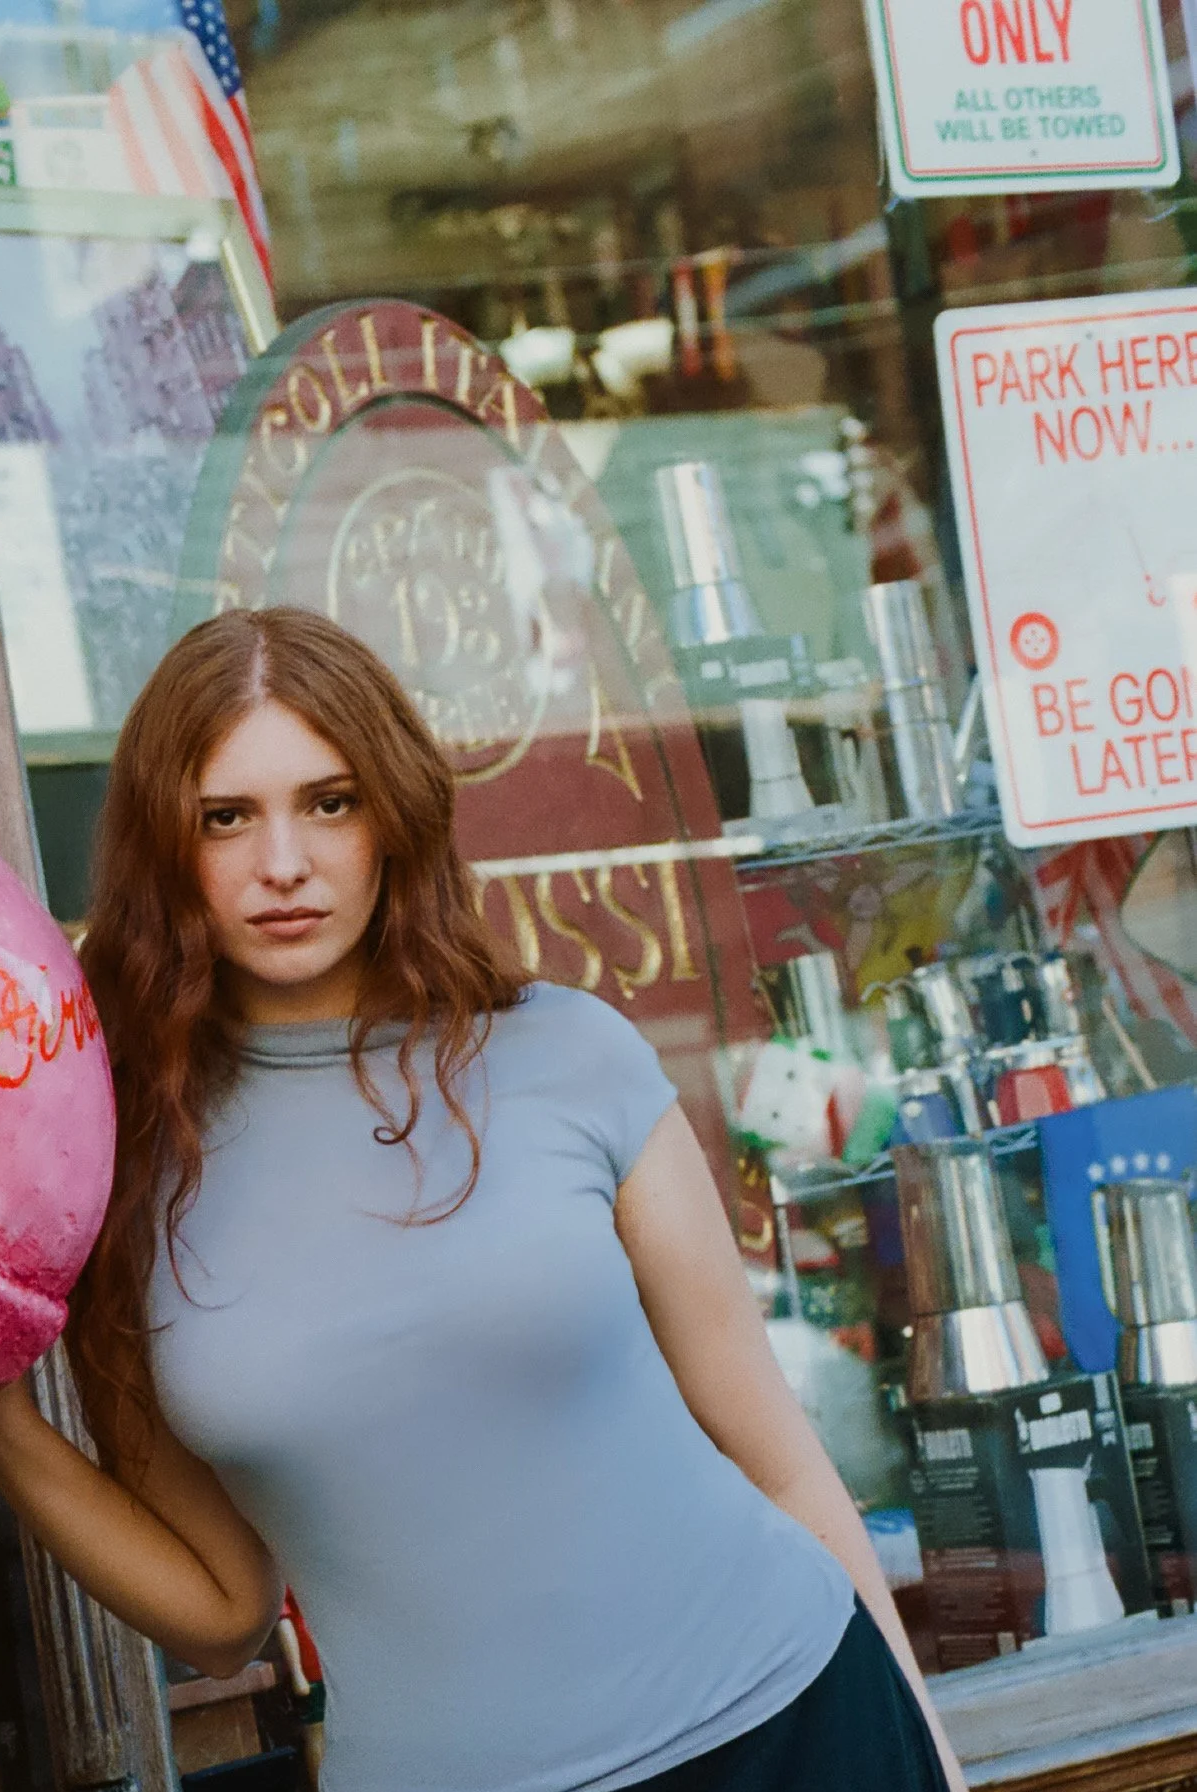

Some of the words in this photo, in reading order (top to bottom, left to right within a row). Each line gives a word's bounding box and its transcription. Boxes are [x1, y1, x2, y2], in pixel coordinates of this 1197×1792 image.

[960, 0, 1073, 65] ONLY
[935, 116, 994, 142] WILL
[1000, 117, 1031, 140] BE
[1038, 113, 1126, 138] TOWED
[954, 87, 998, 112] ALL
[1005, 85, 1101, 111] OTHERS
[972, 342, 1087, 407] PARK
[1031, 678, 1095, 736] BE
